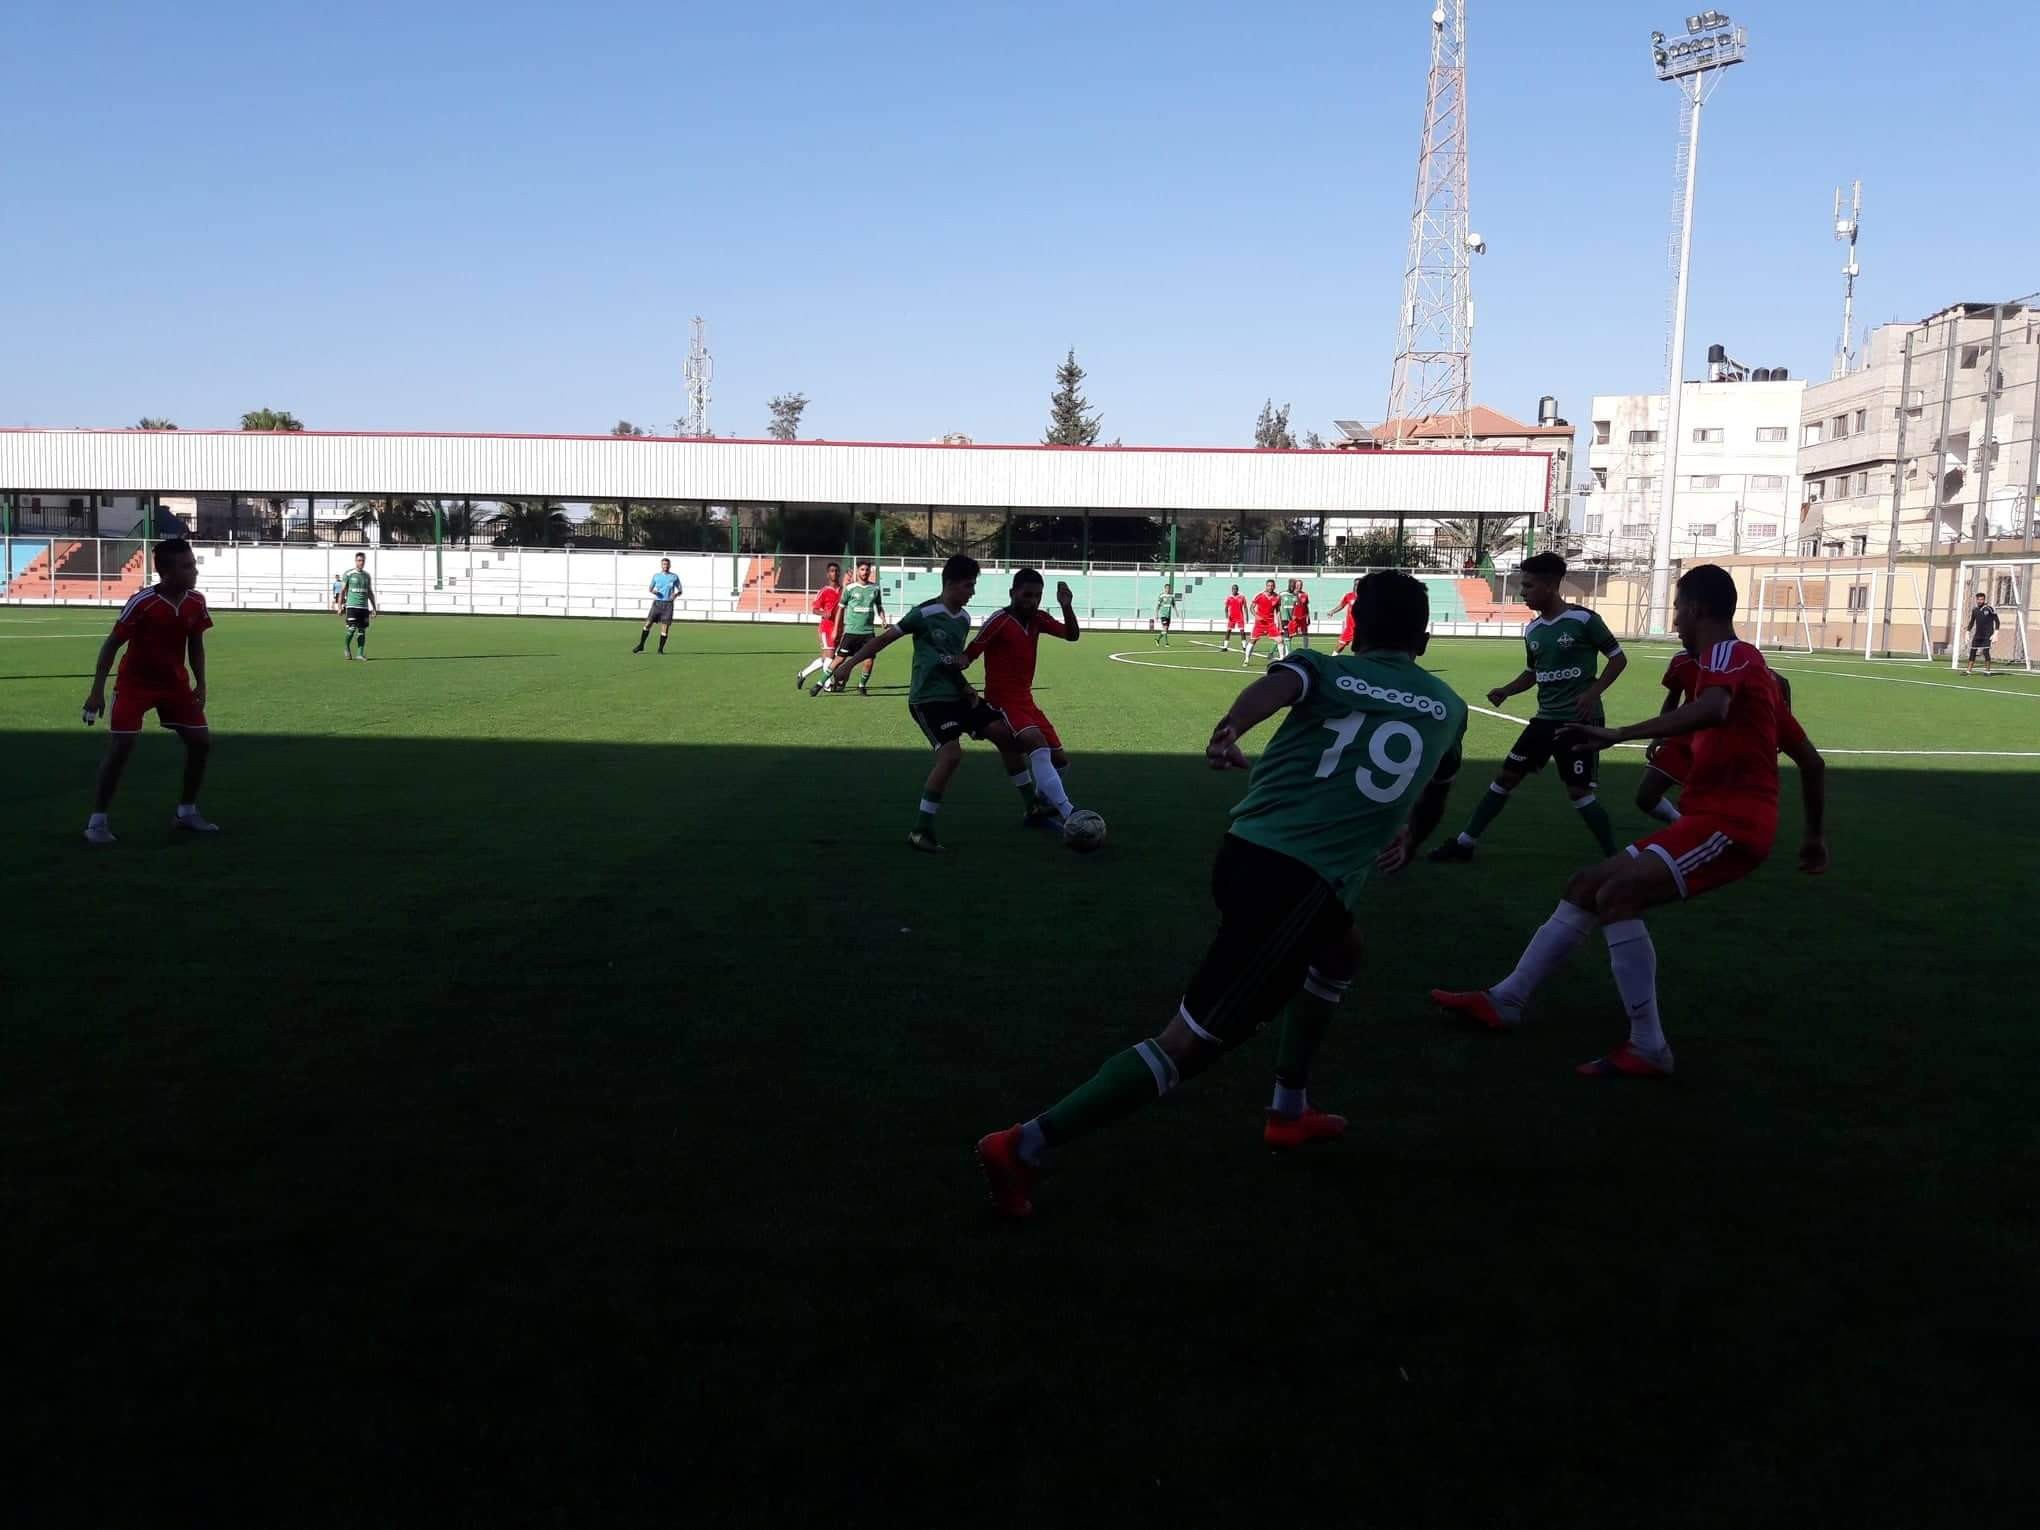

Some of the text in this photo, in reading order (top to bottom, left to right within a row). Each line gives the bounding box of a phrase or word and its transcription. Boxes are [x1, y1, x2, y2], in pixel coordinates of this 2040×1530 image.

[1337, 677, 1446, 719] ooredoo
[1314, 710, 1424, 803] 19
[1573, 760, 1584, 775] 6
